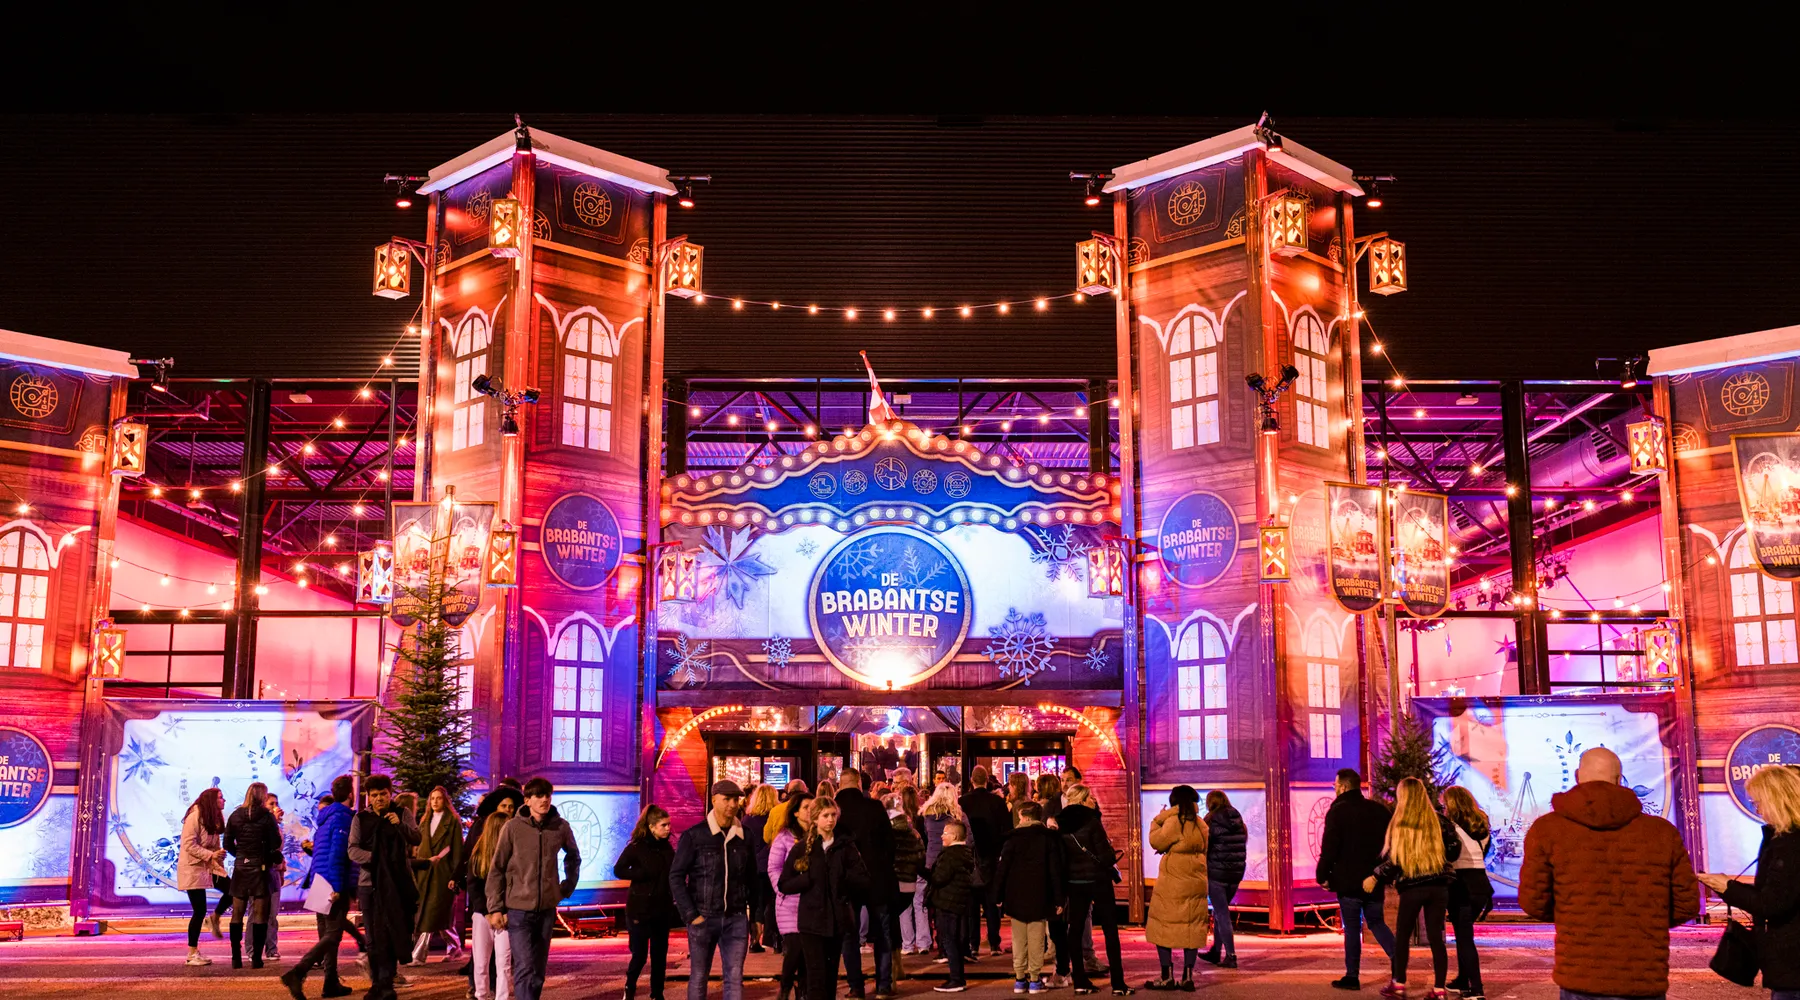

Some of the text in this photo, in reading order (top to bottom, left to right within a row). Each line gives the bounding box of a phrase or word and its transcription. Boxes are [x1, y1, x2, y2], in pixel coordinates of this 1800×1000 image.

[577, 520, 588, 530] DE
[1192, 518, 1202, 528] DE
[545, 528, 617, 551] BRABANTSE
[1162, 526, 1233, 549] BRABANTSE
[1293, 525, 1326, 543] BRABAN
[556, 544, 607, 564] WINTER
[1172, 542, 1223, 562] WINTER
[1760, 544, 1800, 558] BRABAN
[1770, 554, 1800, 567] WINT
[881, 573, 899, 587] DE
[1335, 578, 1379, 590] BRABANTSE
[1342, 587, 1374, 598] WINTER
[1408, 591, 1439, 604] WINTER
[821, 588, 960, 614] BRABANTSE
[841, 612, 940, 638] WINTER
[1768, 753, 1781, 763] DE
[0, 781, 32, 798] TER
